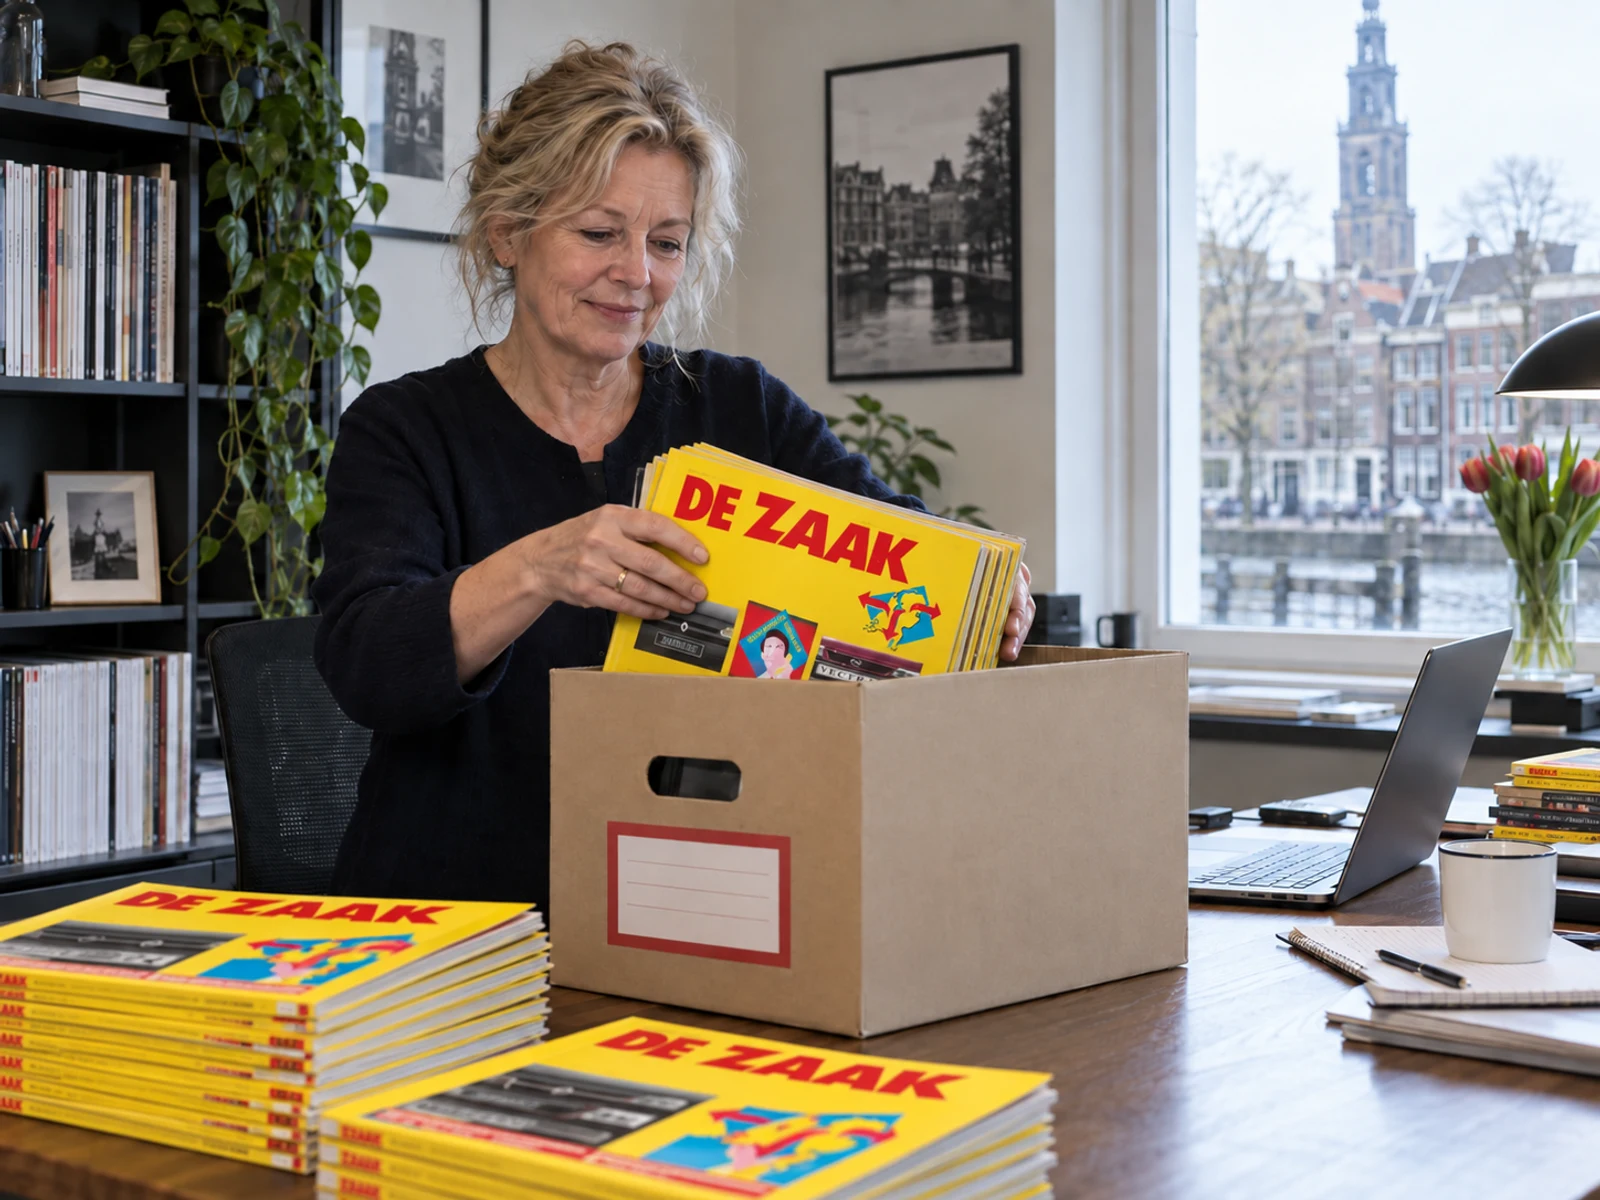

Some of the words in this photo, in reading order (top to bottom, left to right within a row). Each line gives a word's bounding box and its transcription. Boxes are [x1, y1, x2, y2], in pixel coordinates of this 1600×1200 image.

[673, 474, 743, 532] DE
[744, 491, 919, 584] ZAAK
[820, 665, 873, 681] VECTR
[116, 891, 216, 913] DE
[212, 898, 452, 925] ZAAK
[598, 1029, 708, 1060] DE
[701, 1045, 965, 1101] ZAAK
